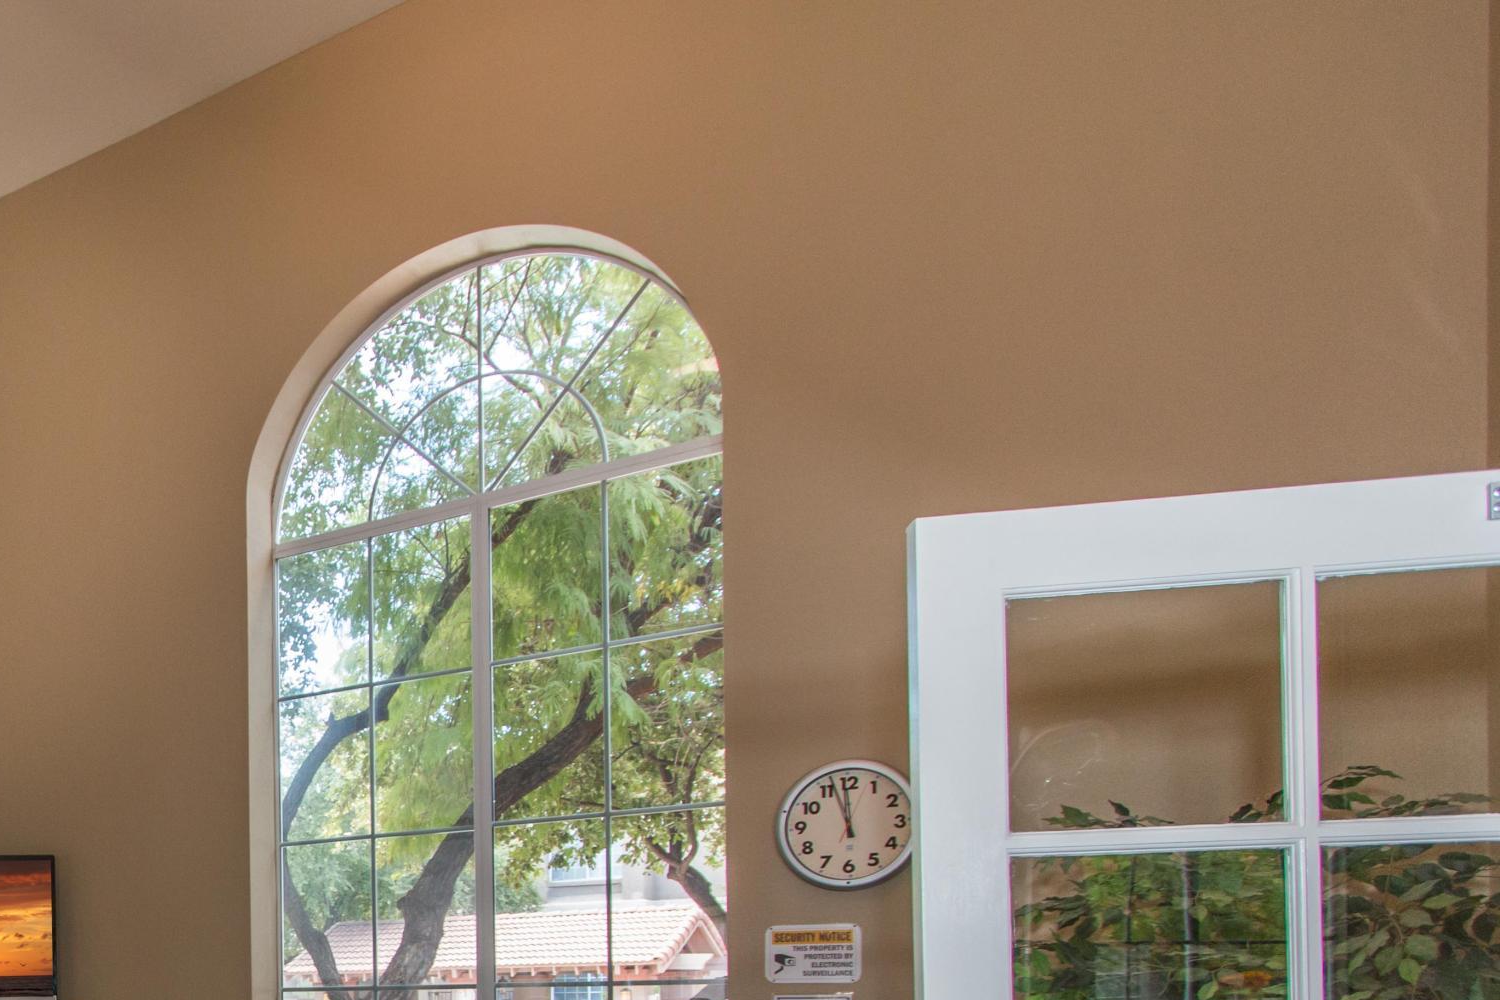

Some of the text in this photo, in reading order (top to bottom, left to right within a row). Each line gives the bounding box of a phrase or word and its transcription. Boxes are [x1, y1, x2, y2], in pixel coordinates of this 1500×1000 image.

[840, 776, 858, 790] 12
[870, 781, 877, 794] 1
[820, 785, 834, 798] 11
[886, 794, 899, 808] 2
[802, 801, 820, 815] 10
[794, 821, 807, 834] 9
[894, 814, 906, 828] 3
[802, 841, 813, 854] 8
[885, 836, 898, 850] 4
[820, 856, 832, 869] 7
[868, 853, 880, 866] 5
[843, 860, 855, 873] 6
[774, 931, 852, 943] SECURITY NOTICE
